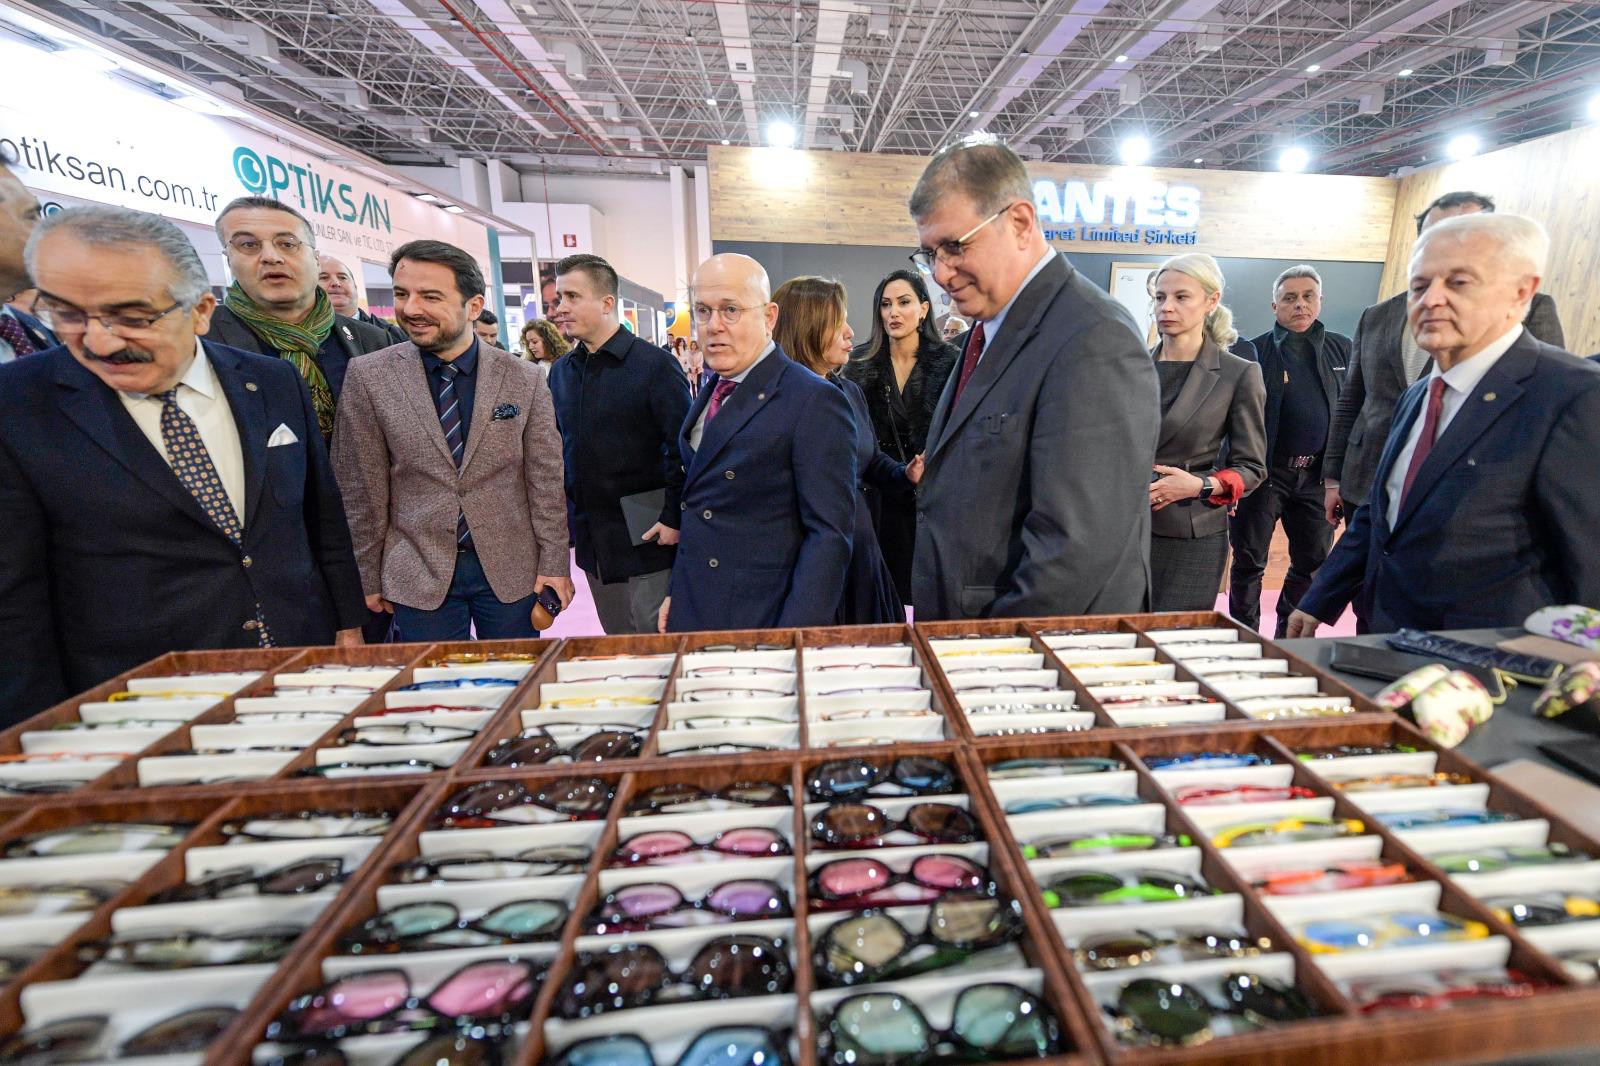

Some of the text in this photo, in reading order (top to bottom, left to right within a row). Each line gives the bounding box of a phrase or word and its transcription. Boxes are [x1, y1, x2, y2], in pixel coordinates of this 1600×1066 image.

[1045, 227, 1197, 246] aret Limited Şirketi
